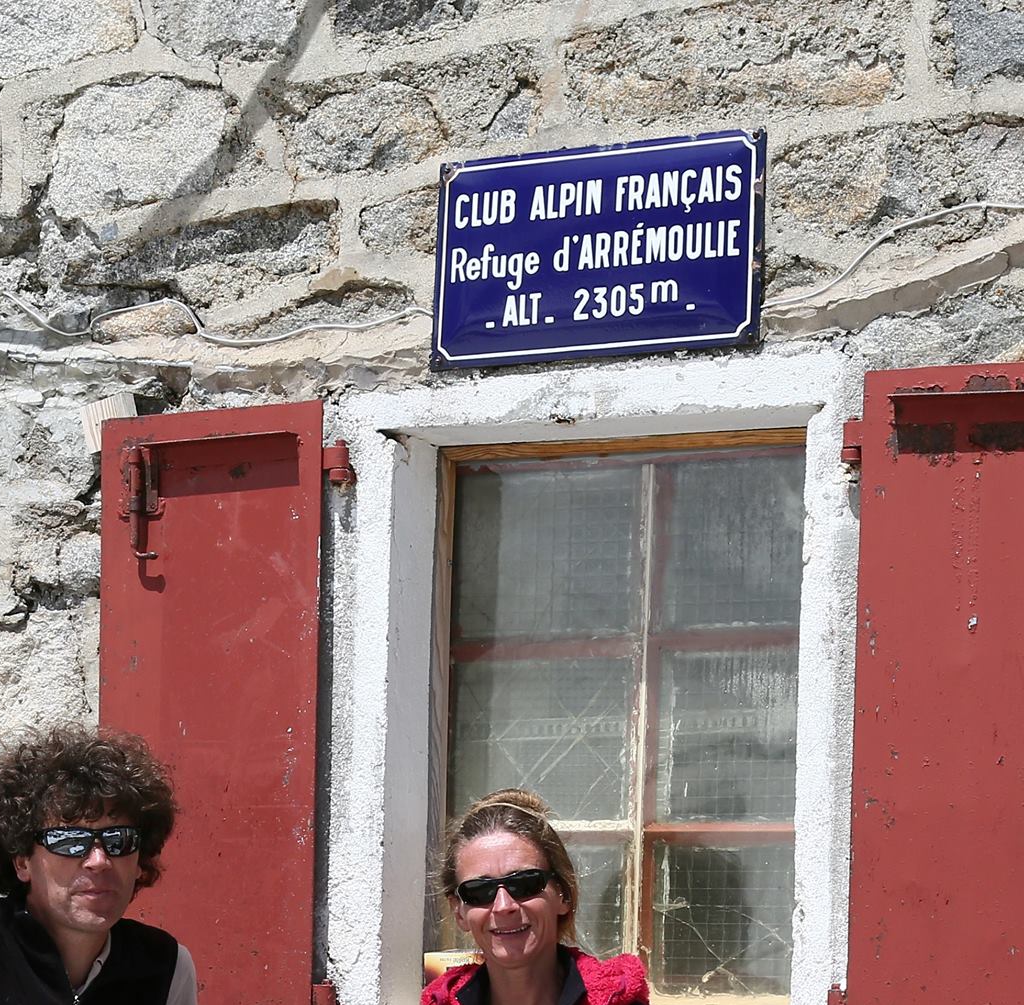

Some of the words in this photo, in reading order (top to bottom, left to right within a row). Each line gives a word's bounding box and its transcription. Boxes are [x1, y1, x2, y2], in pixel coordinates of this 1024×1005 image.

[454, 188, 516, 231] CLUB
[529, 178, 603, 221] ALPIN
[615, 163, 743, 214] FRANÇAIS
[450, 243, 540, 291] Refuge
[553, 218, 741, 273] d'ARRÉMOULIE
